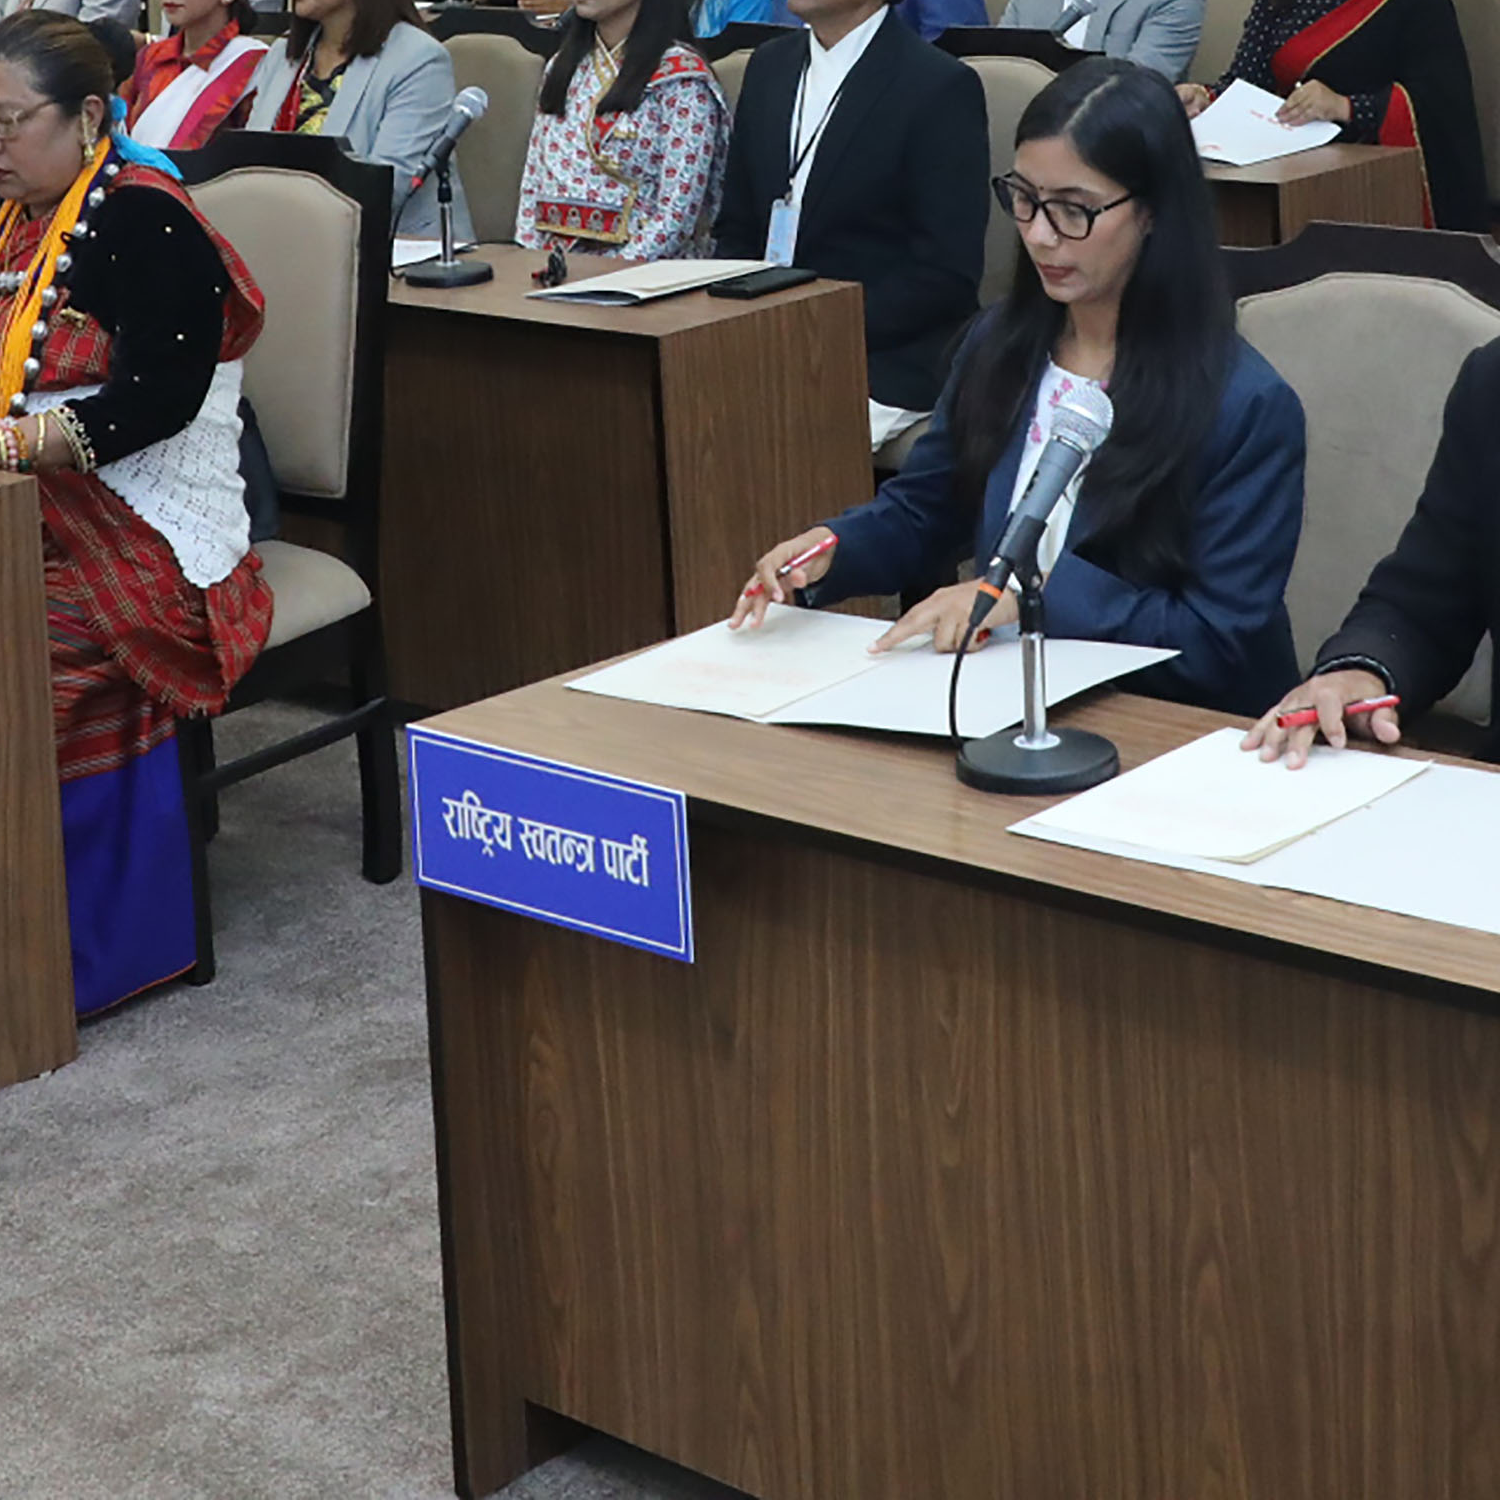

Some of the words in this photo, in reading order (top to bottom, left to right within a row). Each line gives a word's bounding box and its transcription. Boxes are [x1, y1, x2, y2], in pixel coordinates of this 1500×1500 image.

[441, 788, 512, 859] राष्ट्रिय
[517, 816, 595, 873] स्वतन्त्र
[601, 833, 649, 888] पार्टी
